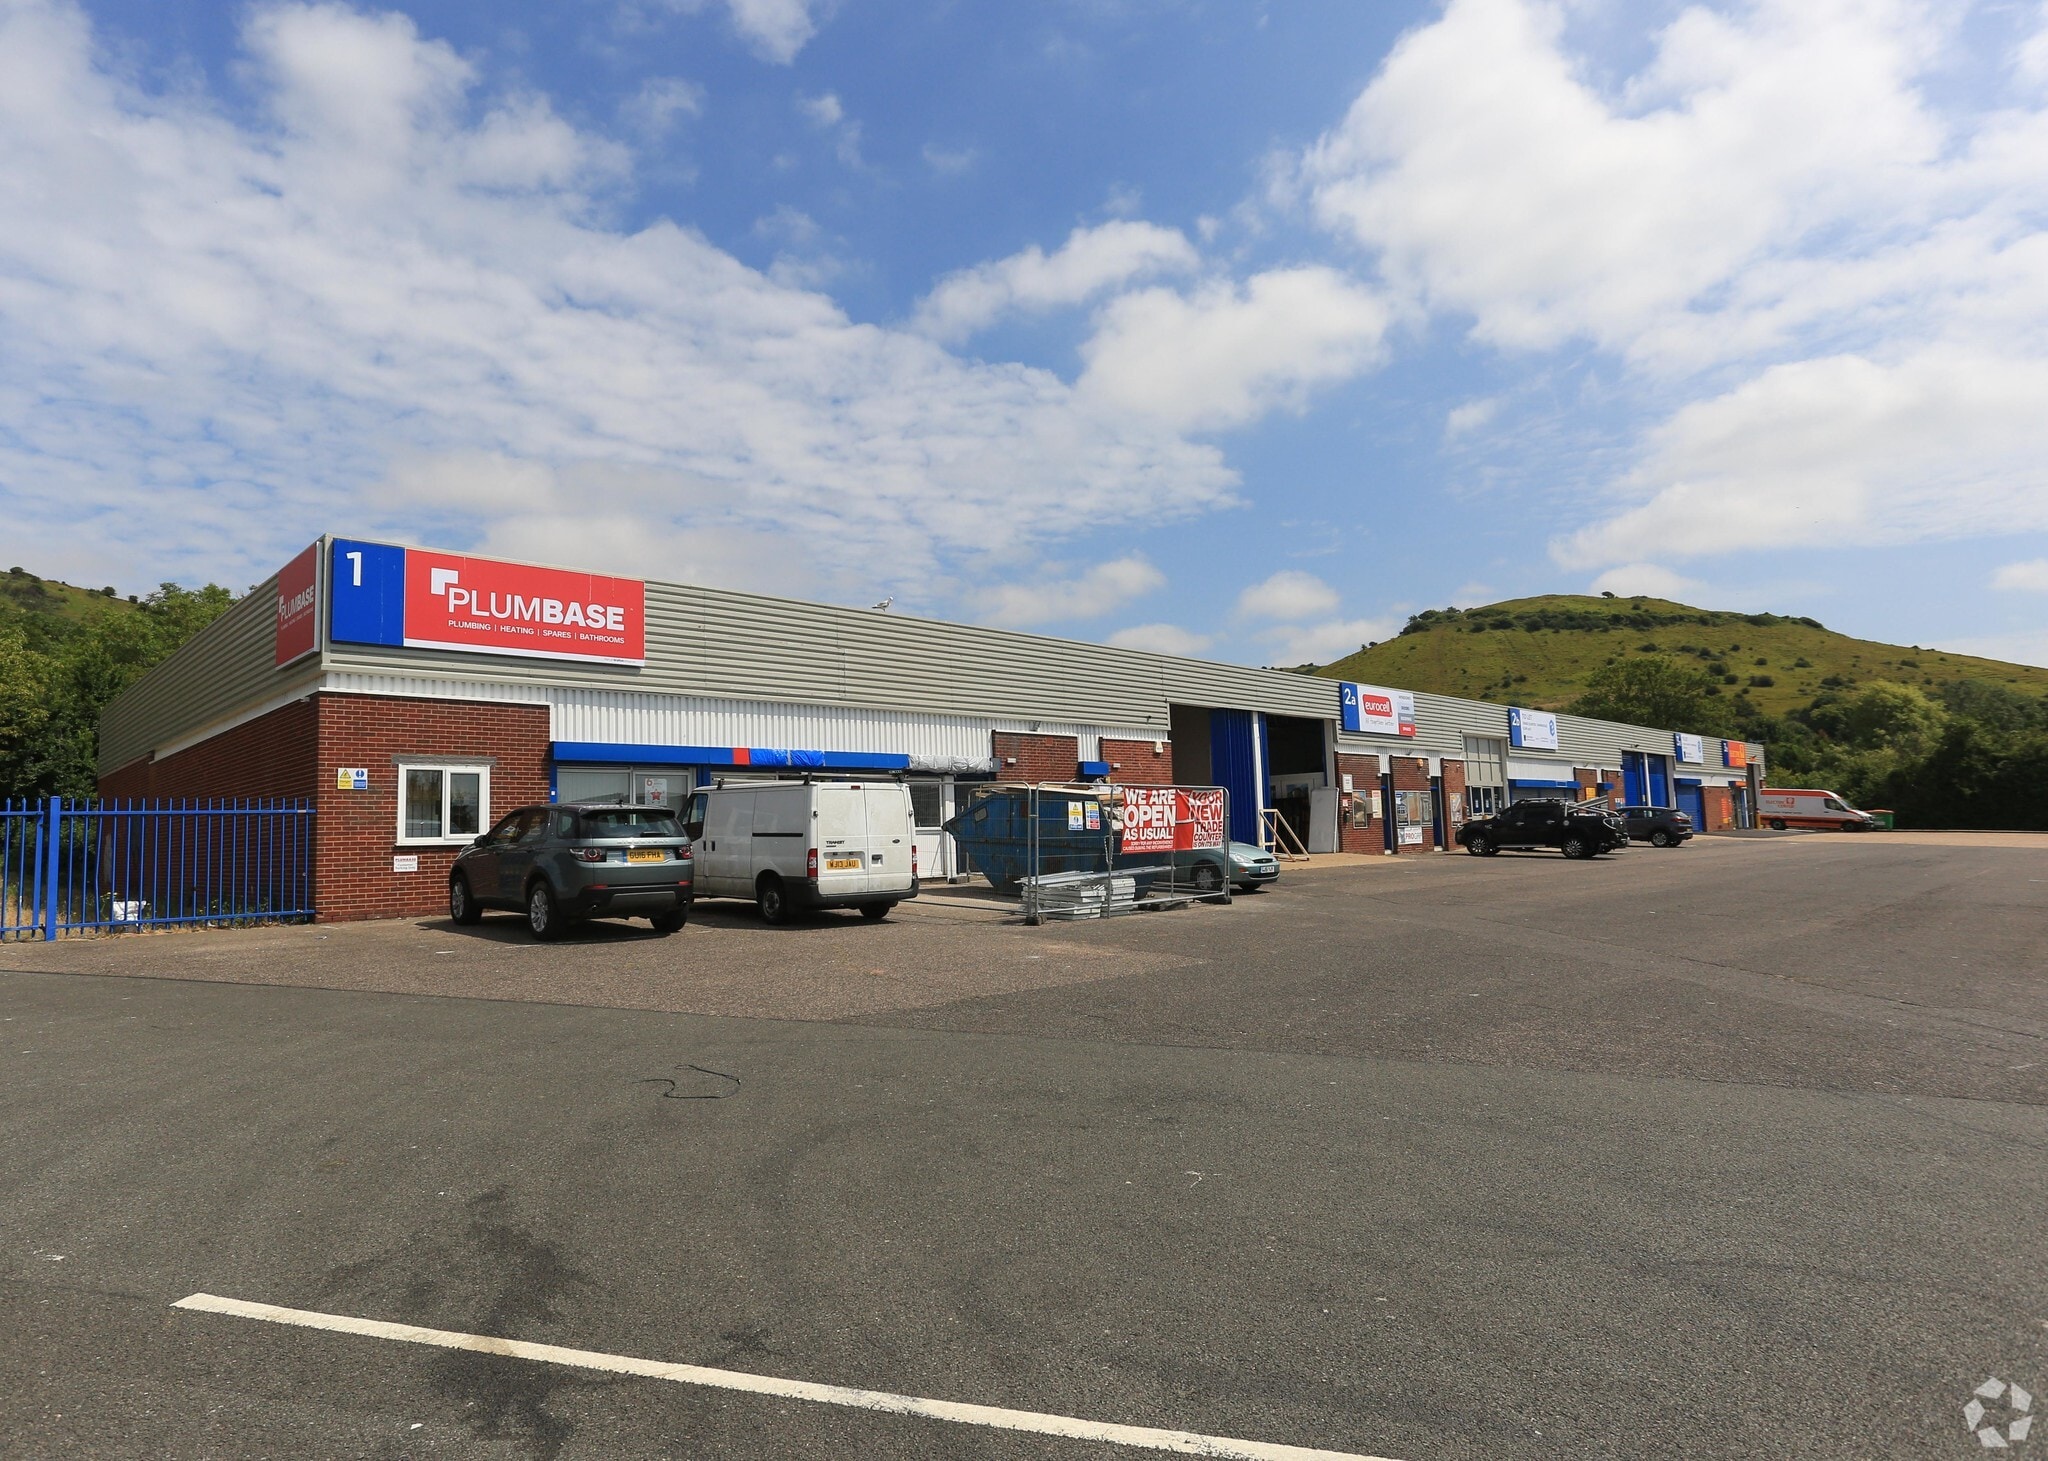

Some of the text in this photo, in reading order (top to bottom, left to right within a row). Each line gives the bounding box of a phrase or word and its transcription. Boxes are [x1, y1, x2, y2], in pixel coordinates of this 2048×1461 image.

[346, 551, 362, 586] 1
[281, 585, 314, 622] PLUMBASE
[448, 587, 625, 632] PLUMBASE
[448, 620, 624, 644] PLUMBING HEATING SPARES BATHROOMS
[1344, 688, 1357, 705] 2a
[1365, 701, 1390, 713] eurocell
[1125, 788, 1176, 804] WE ARE
[1192, 791, 1222, 804] YOUR
[1124, 804, 1176, 828] OPEN
[1190, 805, 1222, 821] NEW
[1123, 827, 1174, 841] AS USUAL!
[1195, 821, 1223, 833] TRADE
[1194, 833, 1222, 841] COUNTER
[629, 851, 646, 860] GU16
